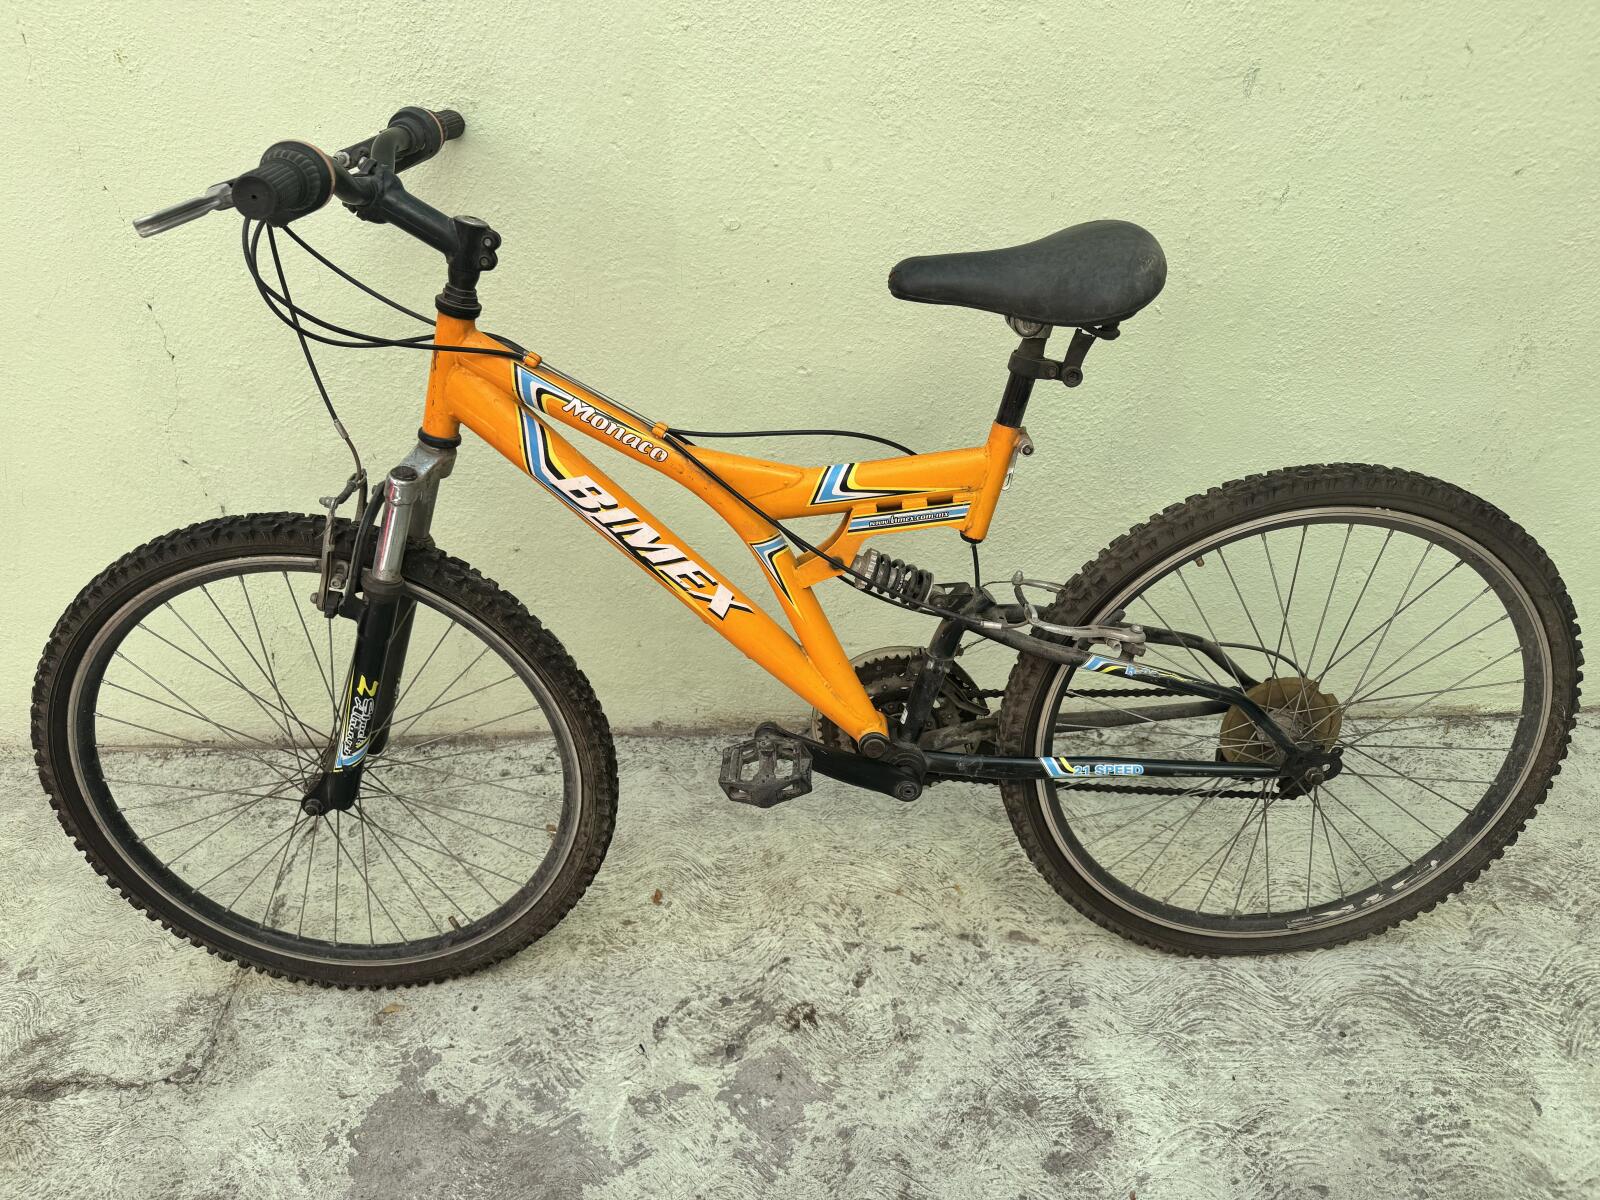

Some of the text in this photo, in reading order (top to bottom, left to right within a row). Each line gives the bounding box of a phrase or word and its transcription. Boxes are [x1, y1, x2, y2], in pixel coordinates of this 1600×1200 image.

[562, 397, 669, 463] Monaco
[558, 475, 754, 621] BIMEX
[1073, 764, 1144, 776] 21 SPEED
